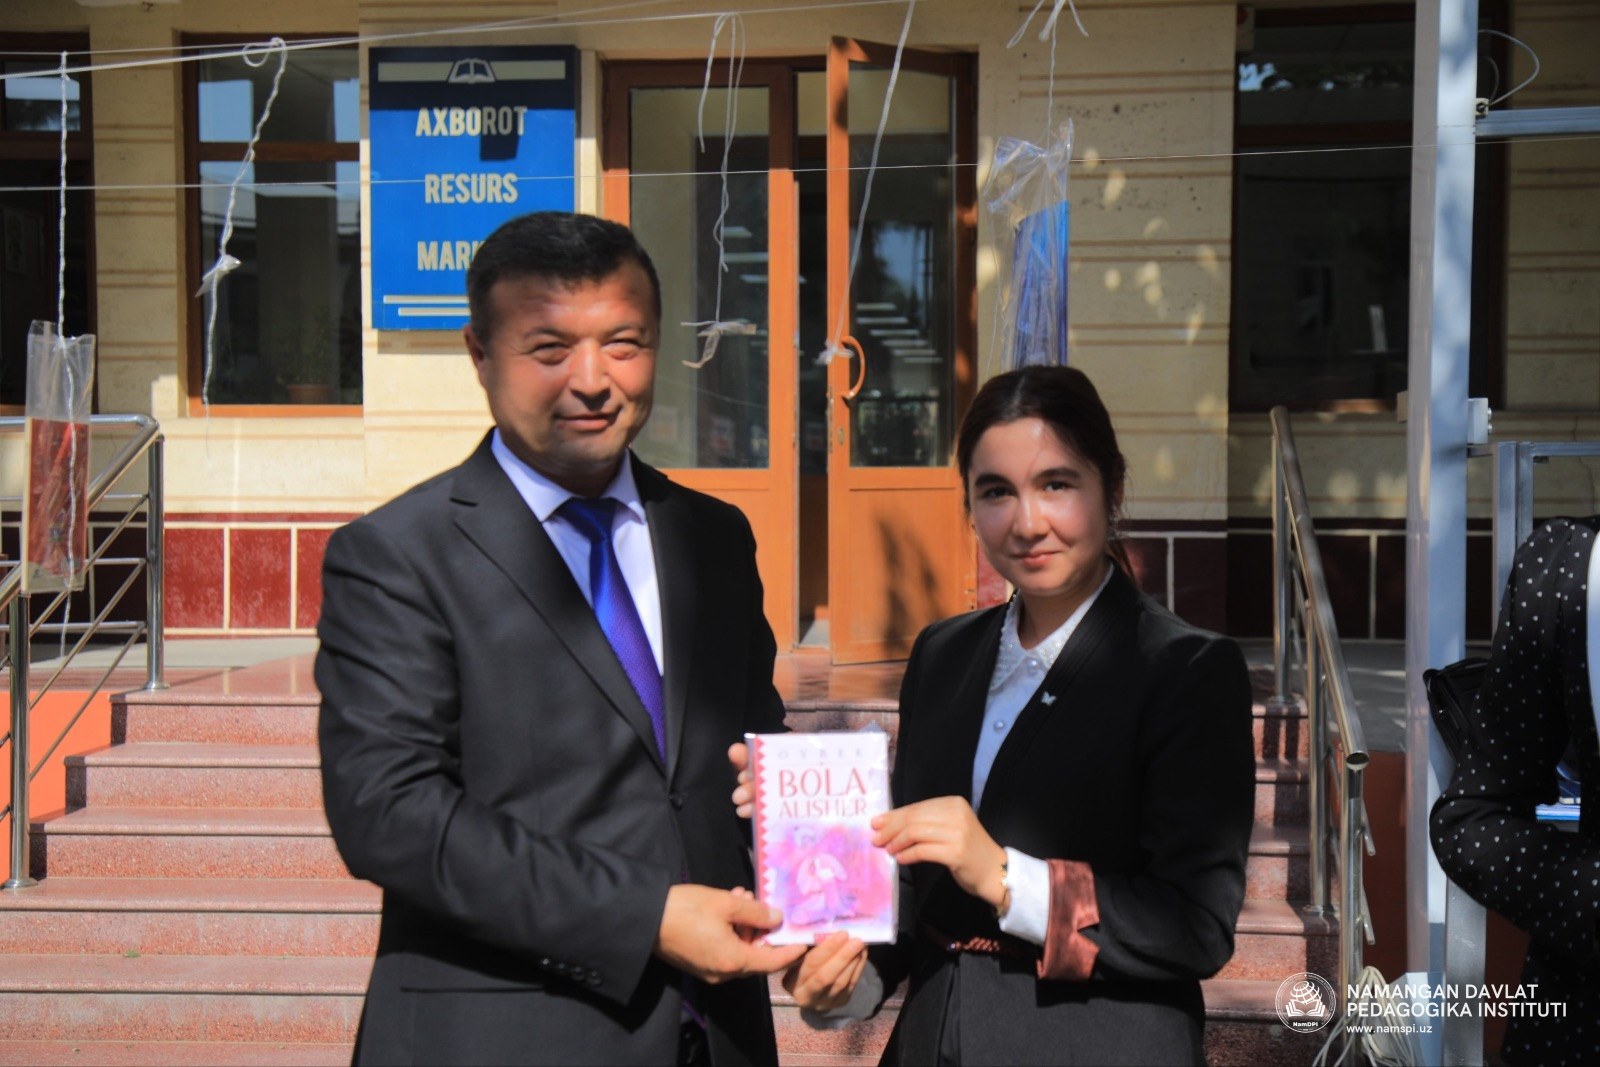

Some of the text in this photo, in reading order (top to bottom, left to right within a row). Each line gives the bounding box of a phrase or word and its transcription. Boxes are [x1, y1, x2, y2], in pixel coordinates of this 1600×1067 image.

[415, 106, 528, 137] AXBOROT
[424, 173, 519, 204] RESURS
[778, 766, 868, 798] BOLA
[779, 798, 868, 819] ALISHER
